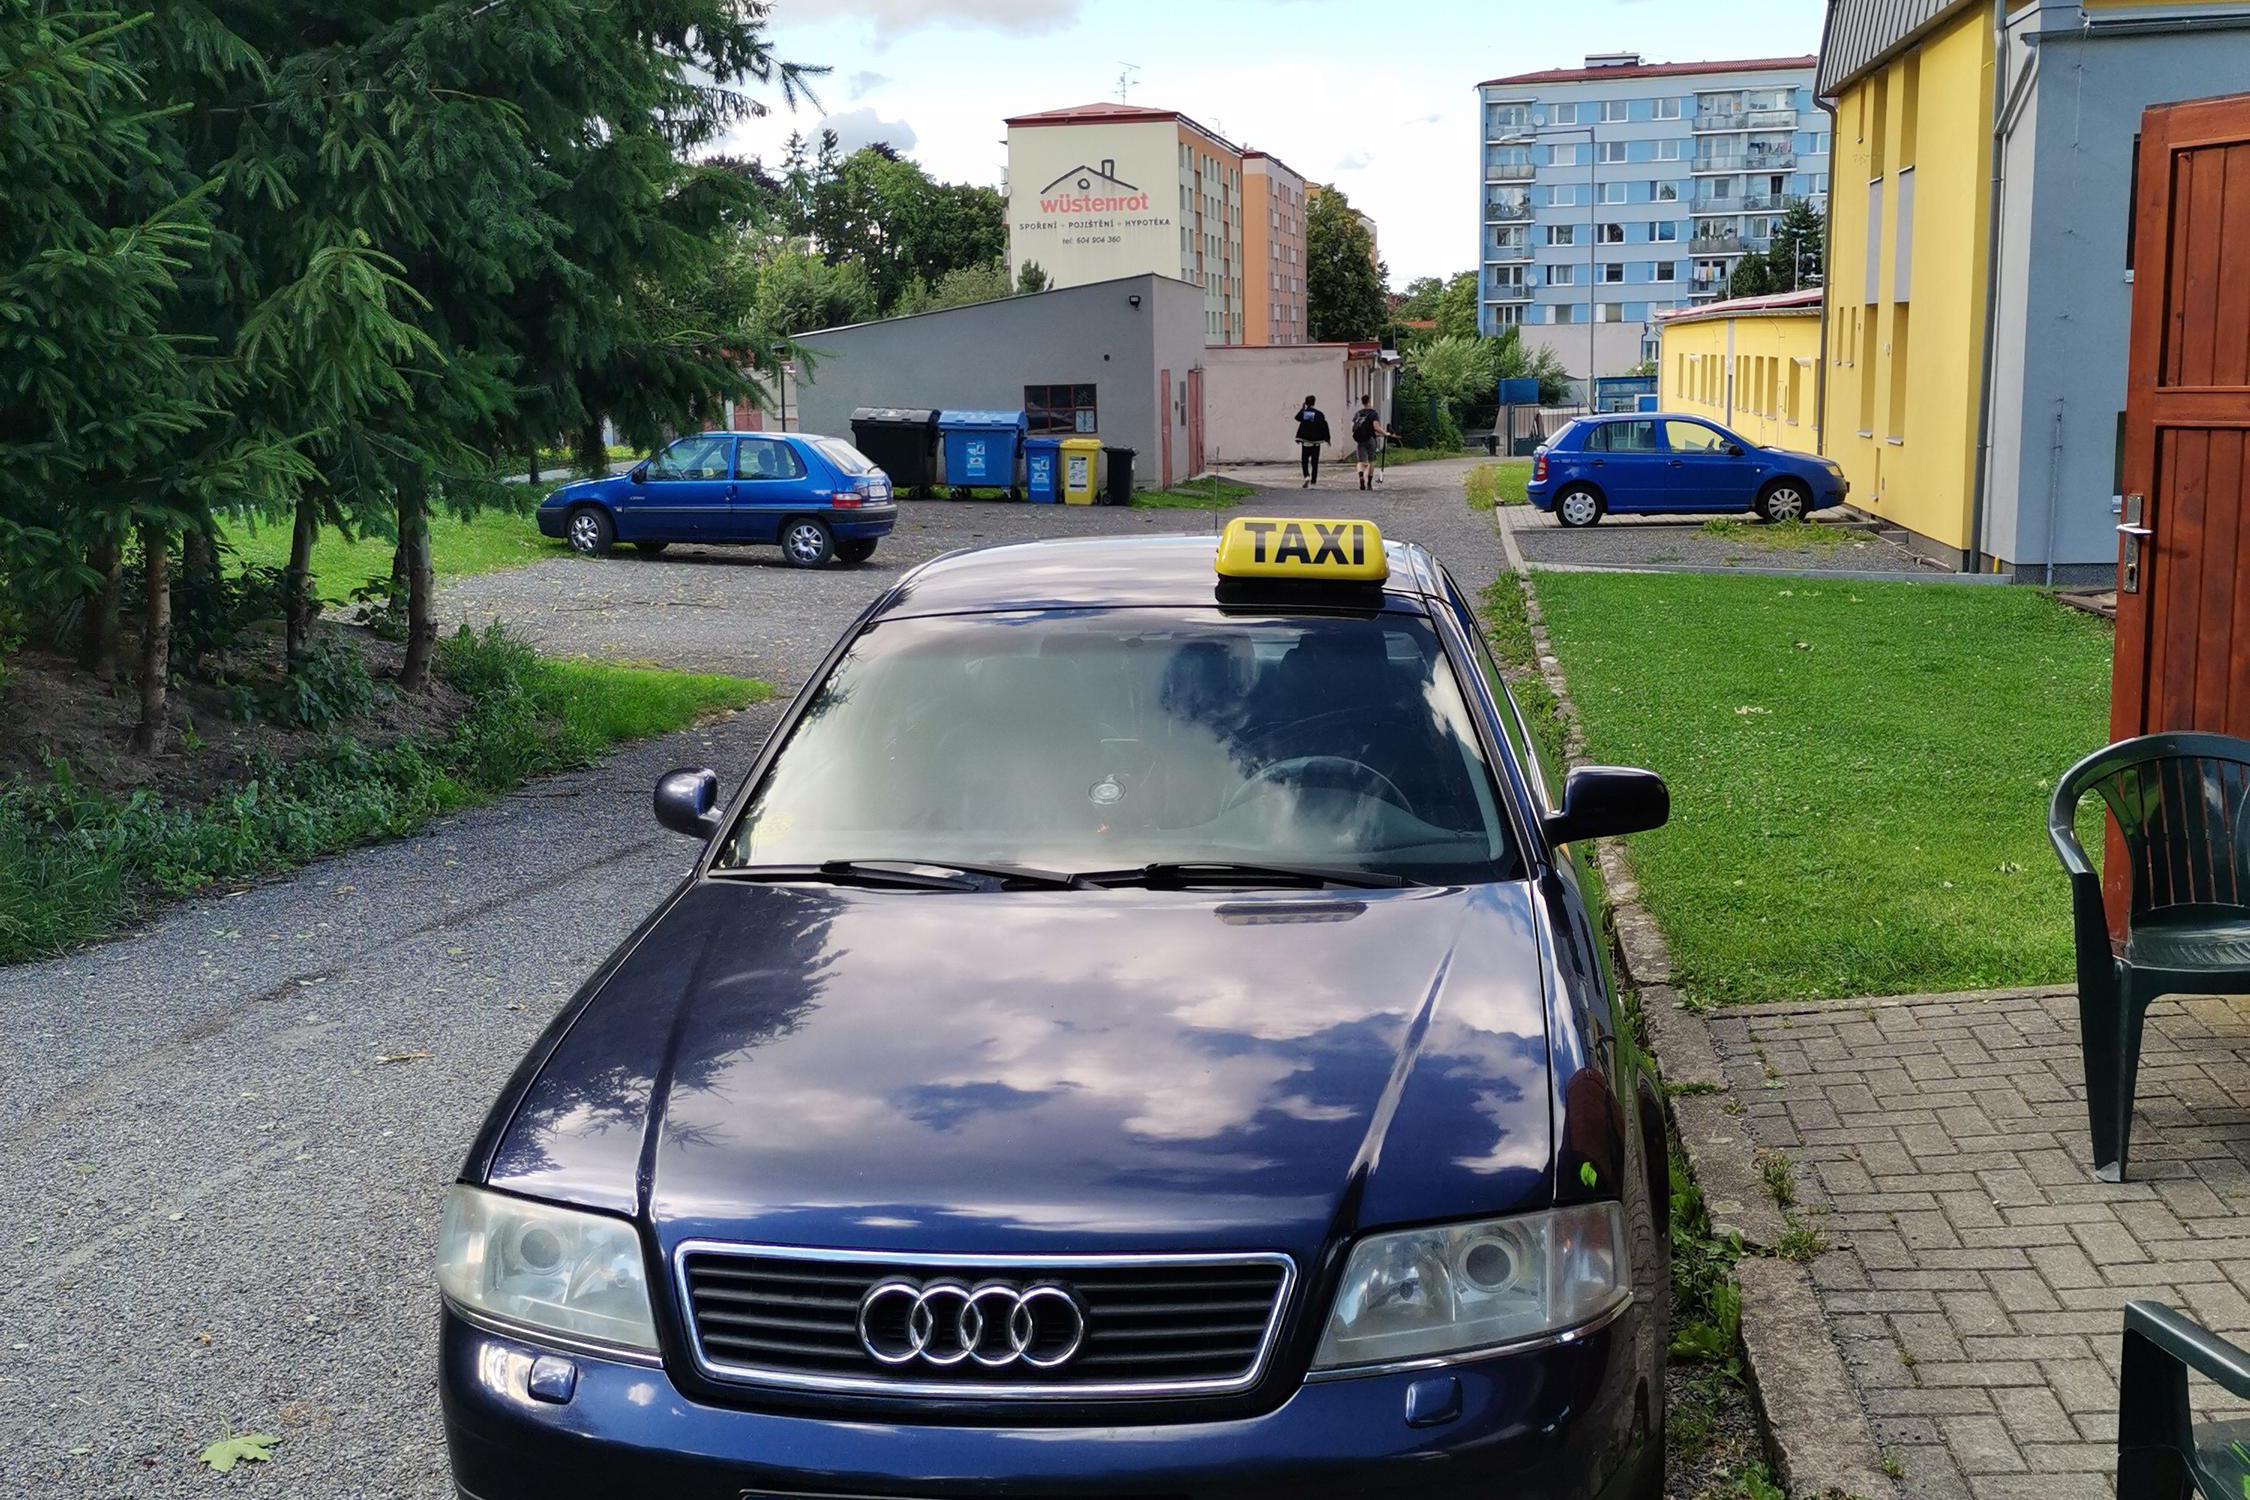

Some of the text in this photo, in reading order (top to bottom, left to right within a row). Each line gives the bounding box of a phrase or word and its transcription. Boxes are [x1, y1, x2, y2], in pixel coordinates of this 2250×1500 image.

[1040, 192, 1149, 213] wüstenrot
[1019, 217, 1171, 230] SPOŘENÍ POJIŠTĚNÍ HYPOTÉKA
[1245, 523, 1364, 565] TAXI
